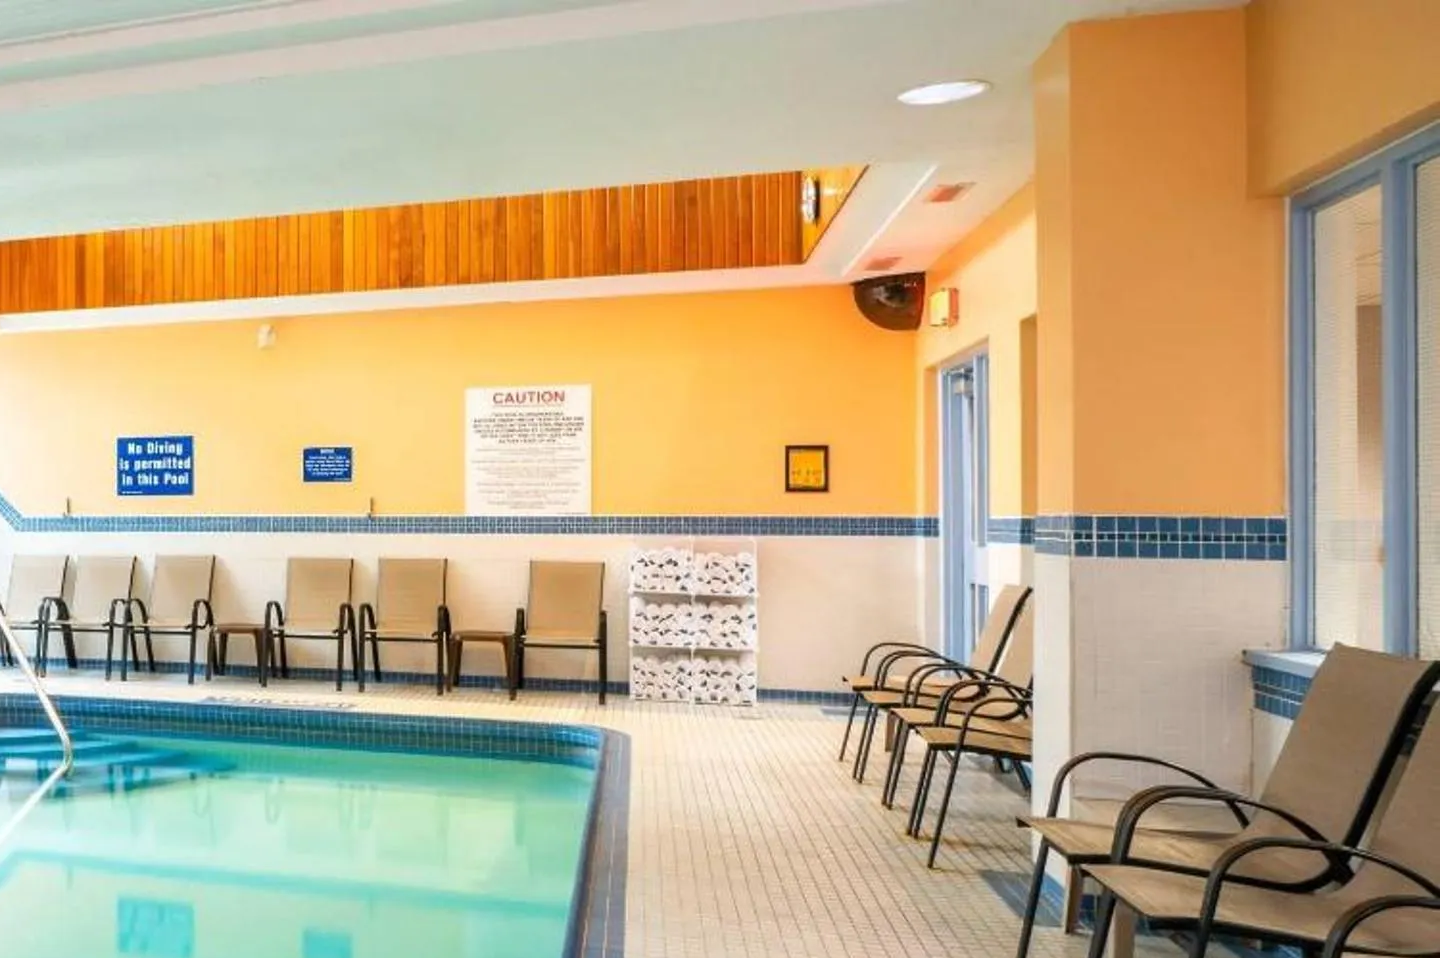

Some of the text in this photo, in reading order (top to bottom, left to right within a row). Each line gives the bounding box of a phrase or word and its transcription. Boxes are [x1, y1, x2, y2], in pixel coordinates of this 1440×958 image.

[492, 390, 565, 404] CAUTION
[128, 441, 184, 455] No Diving
[120, 457, 191, 471] is permitted
[122, 472, 189, 485] in this Pool
